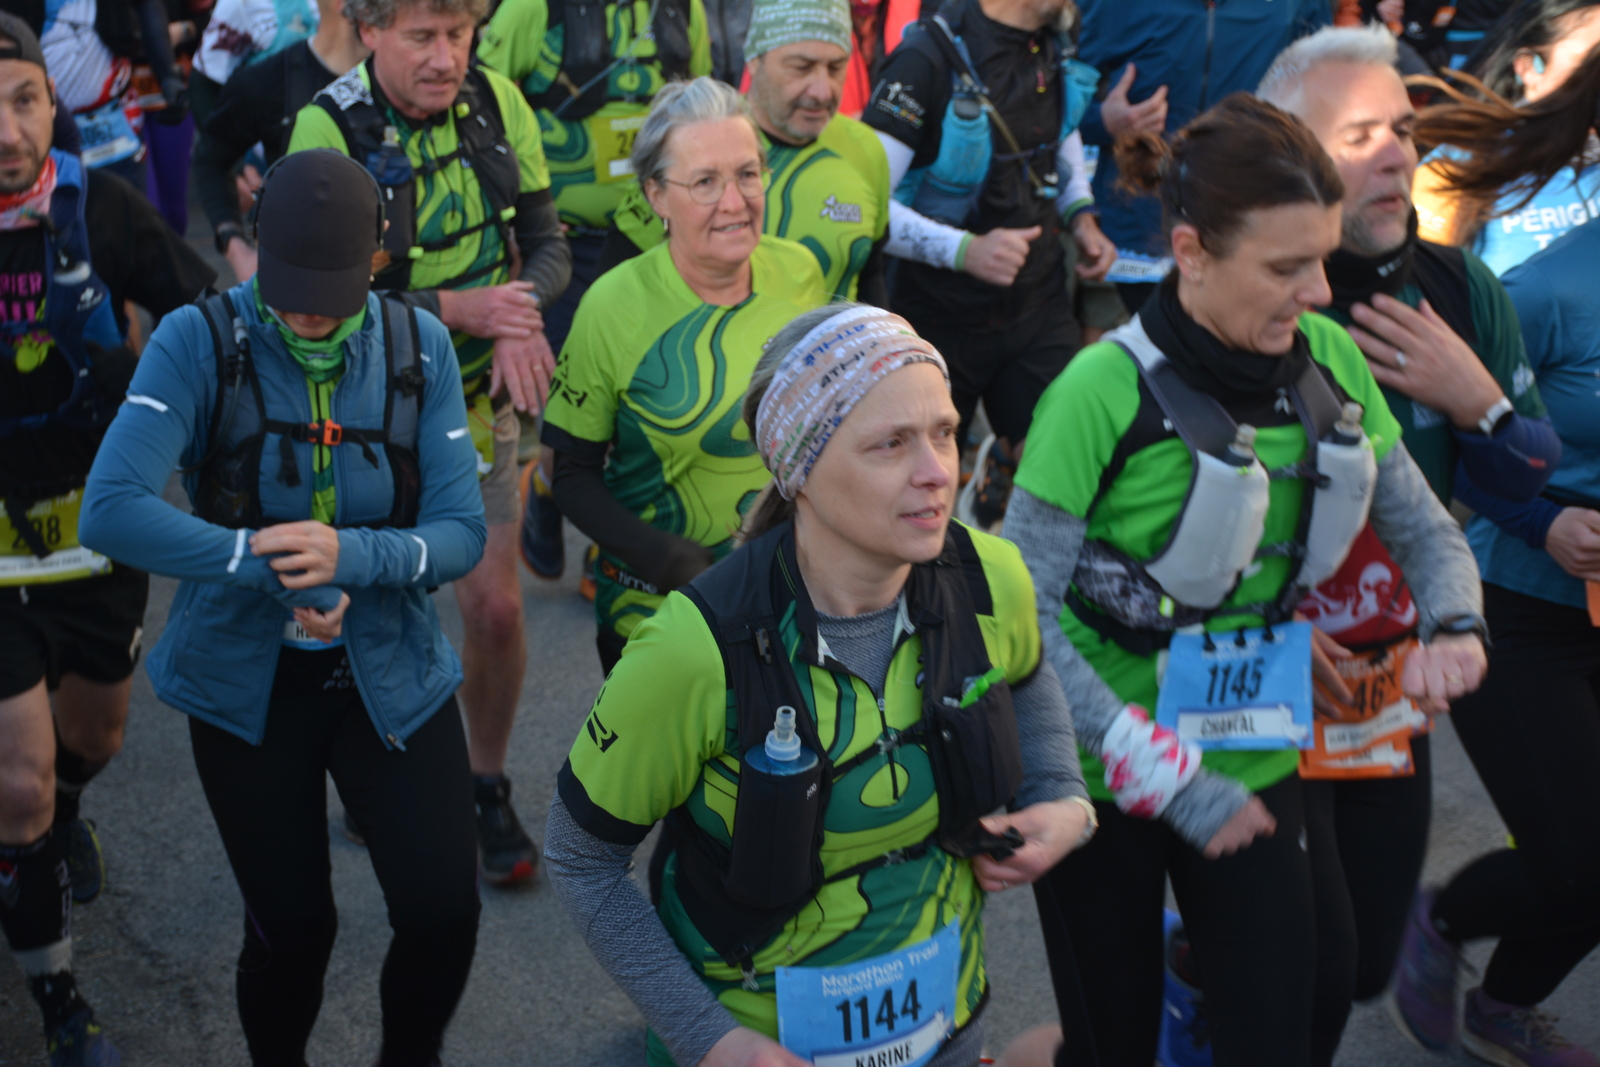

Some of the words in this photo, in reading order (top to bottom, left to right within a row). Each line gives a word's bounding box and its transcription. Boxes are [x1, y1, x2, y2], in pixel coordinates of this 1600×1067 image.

[1207, 659, 1264, 704] 1145
[821, 958, 904, 990] Marathon
[907, 940, 940, 967] Trail
[836, 977, 922, 1043] 1144
